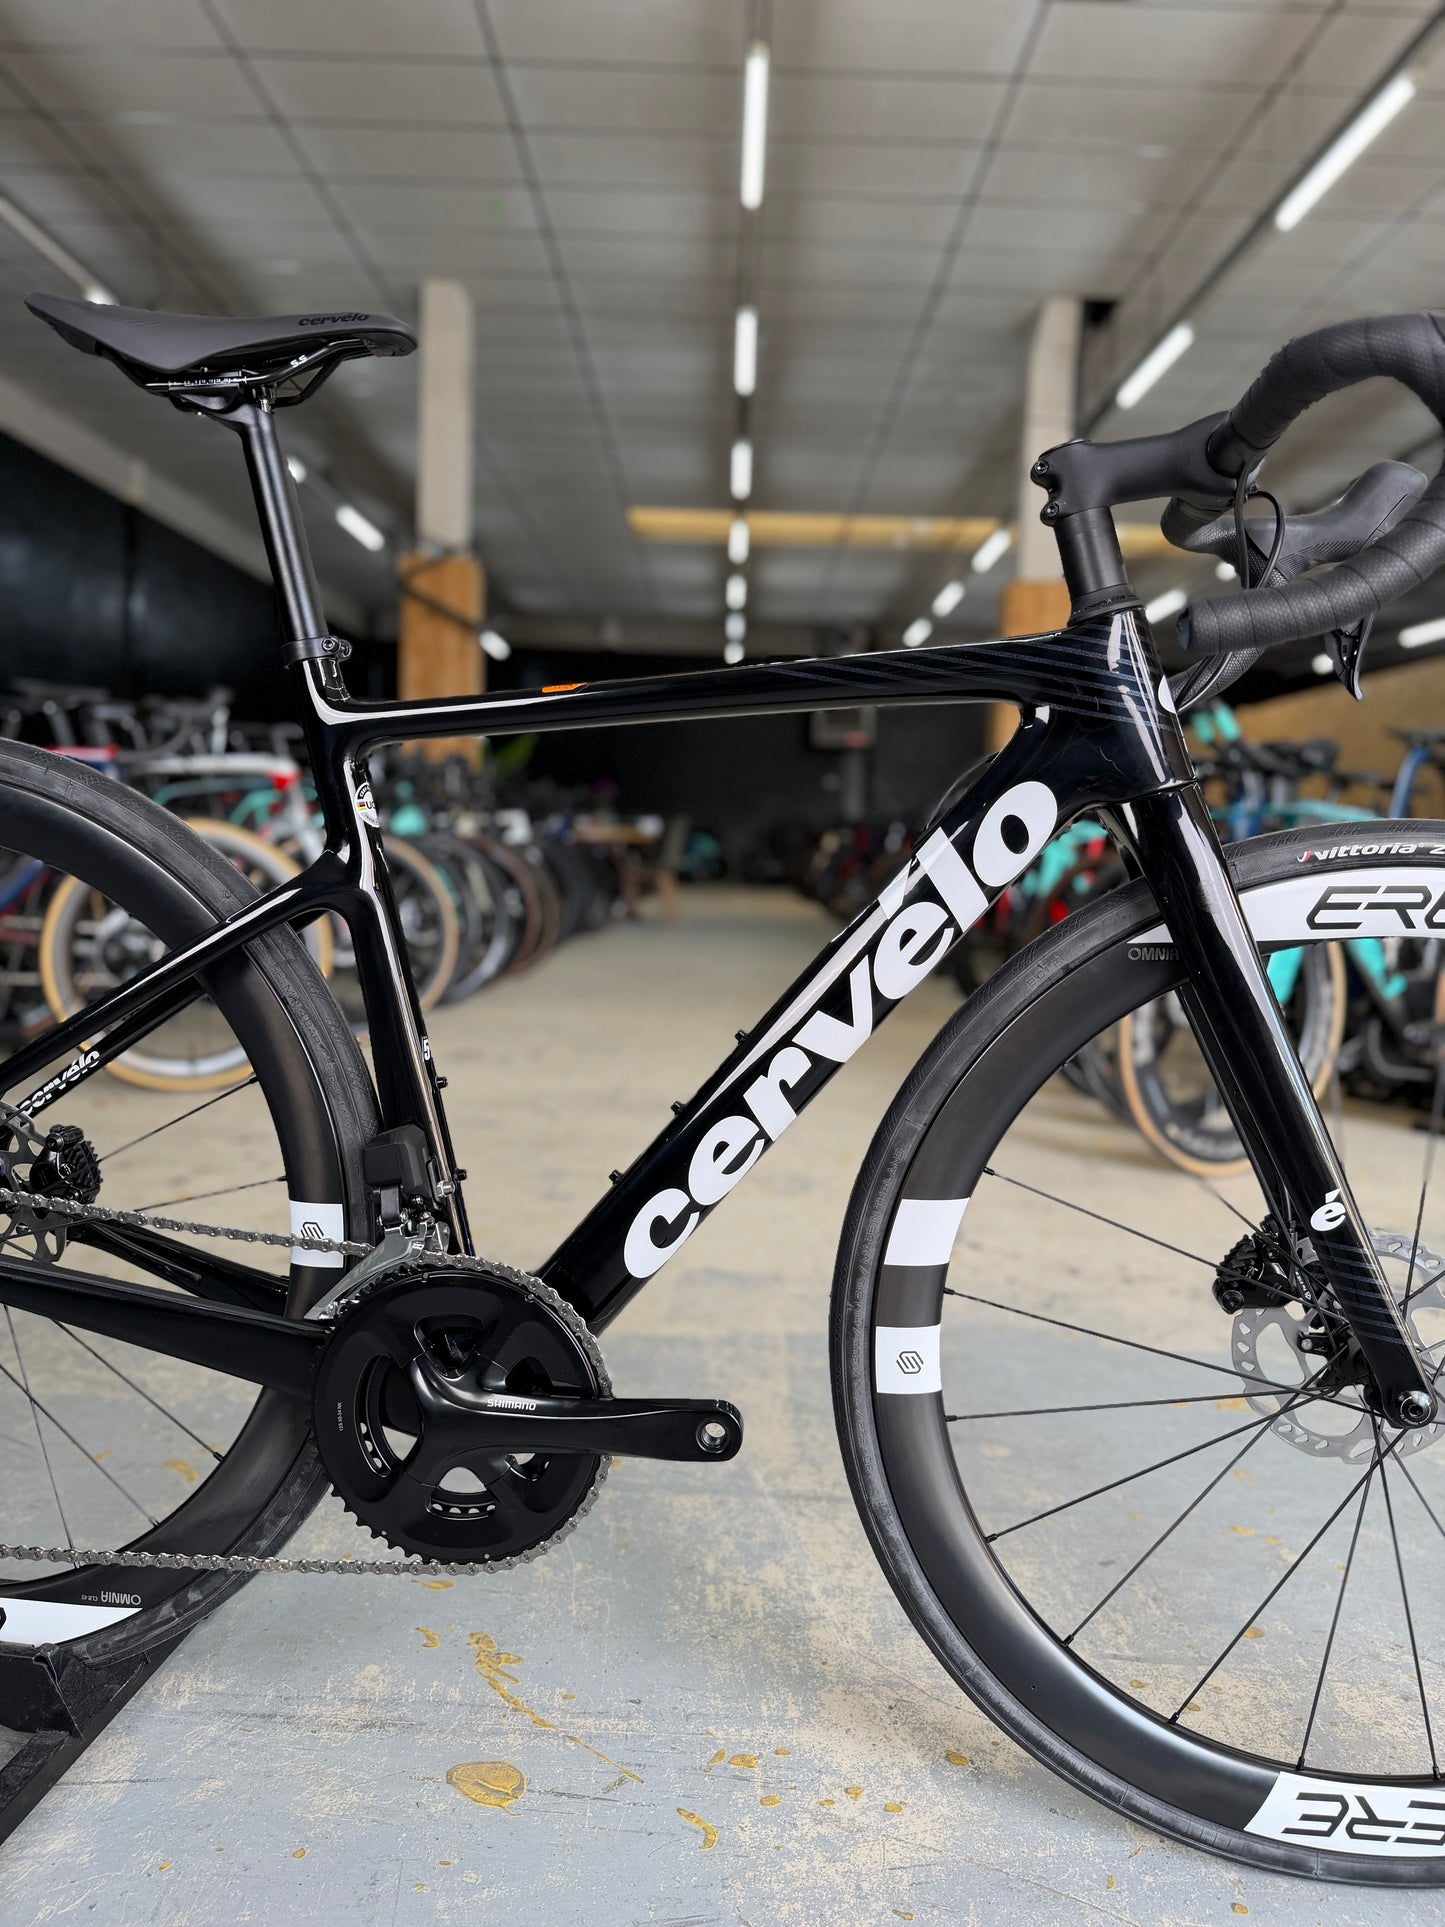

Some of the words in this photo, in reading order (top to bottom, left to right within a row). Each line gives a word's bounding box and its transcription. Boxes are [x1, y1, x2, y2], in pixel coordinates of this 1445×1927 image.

[298, 312, 369, 326] cervélo
[1313, 842, 1417, 861] vittoria
[624, 780, 1058, 1279] cervélo
[874, 1147, 905, 1211] THAILAND
[1310, 1188, 1346, 1231] é
[487, 1398, 537, 1411] SHIMANO
[101, 1591, 142, 1605] OMNIA
